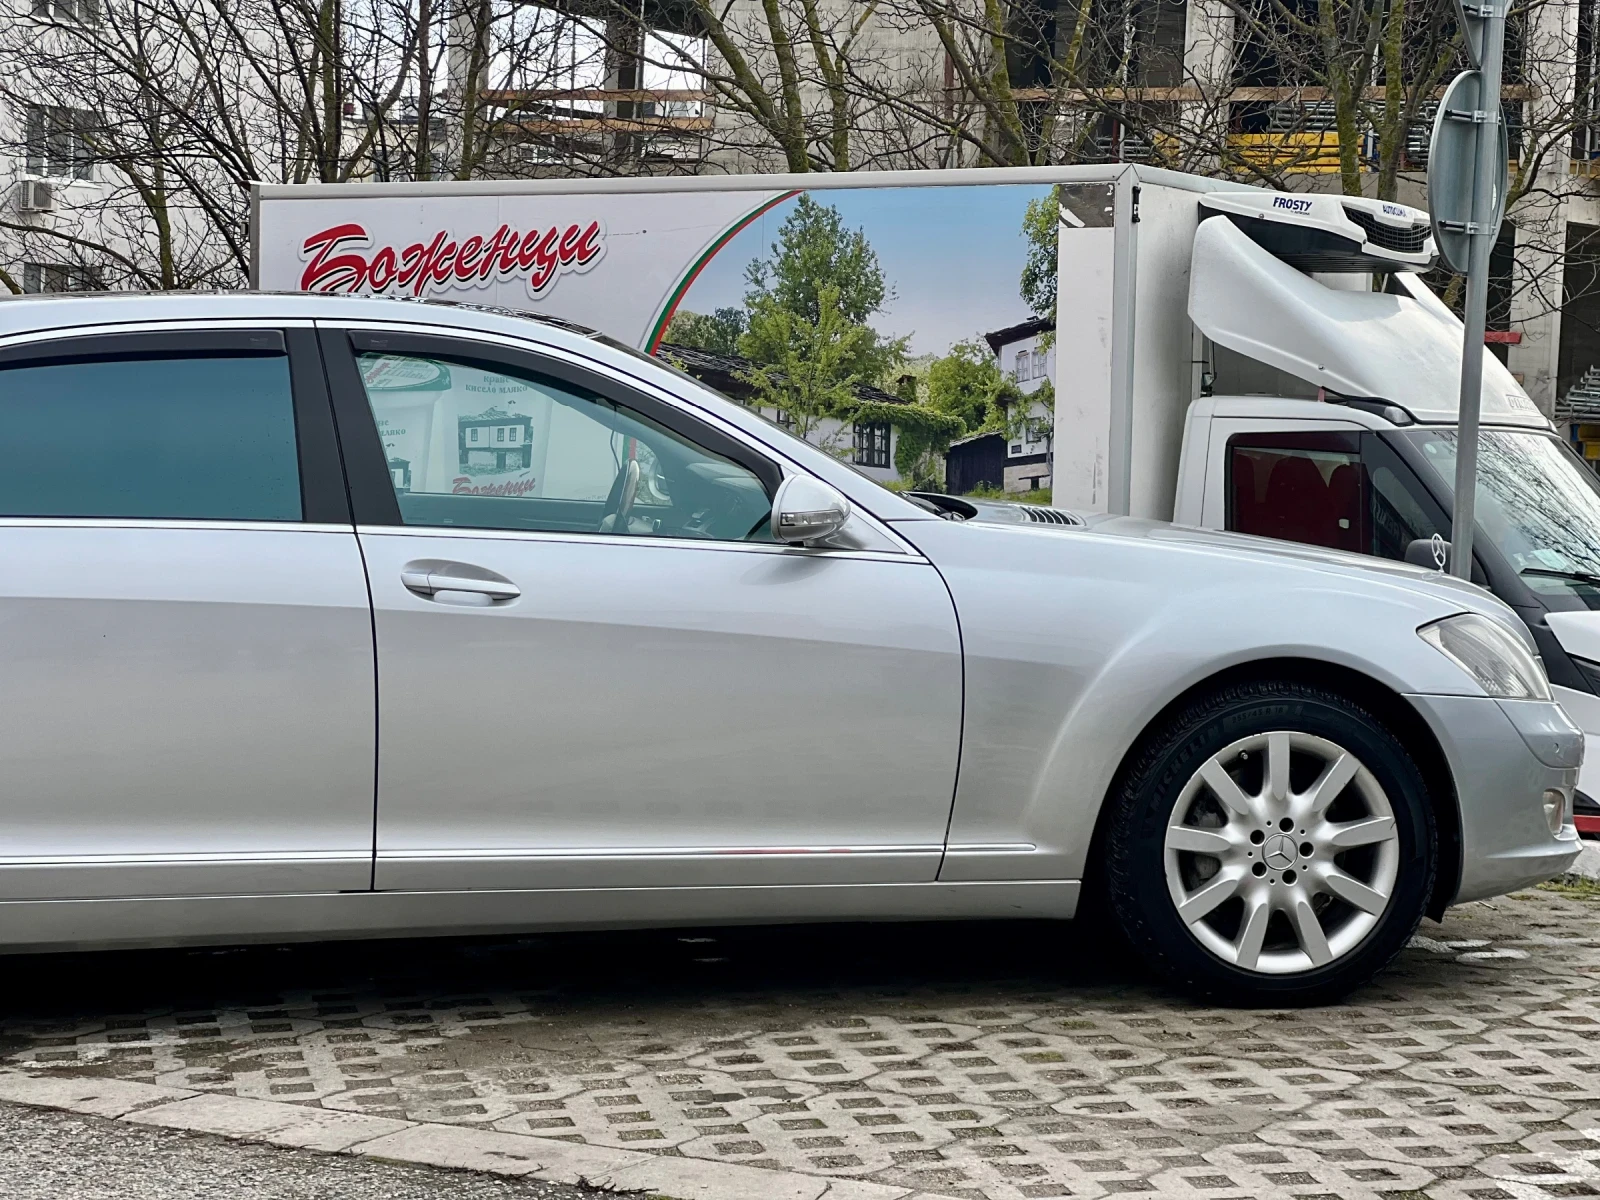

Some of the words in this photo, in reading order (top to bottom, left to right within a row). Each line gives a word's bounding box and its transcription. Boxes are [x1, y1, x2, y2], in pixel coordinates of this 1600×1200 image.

[1273, 196, 1313, 211] FROSTY
[300, 220, 602, 298] Боженци
[1149, 725, 1220, 813] MICHELIN
